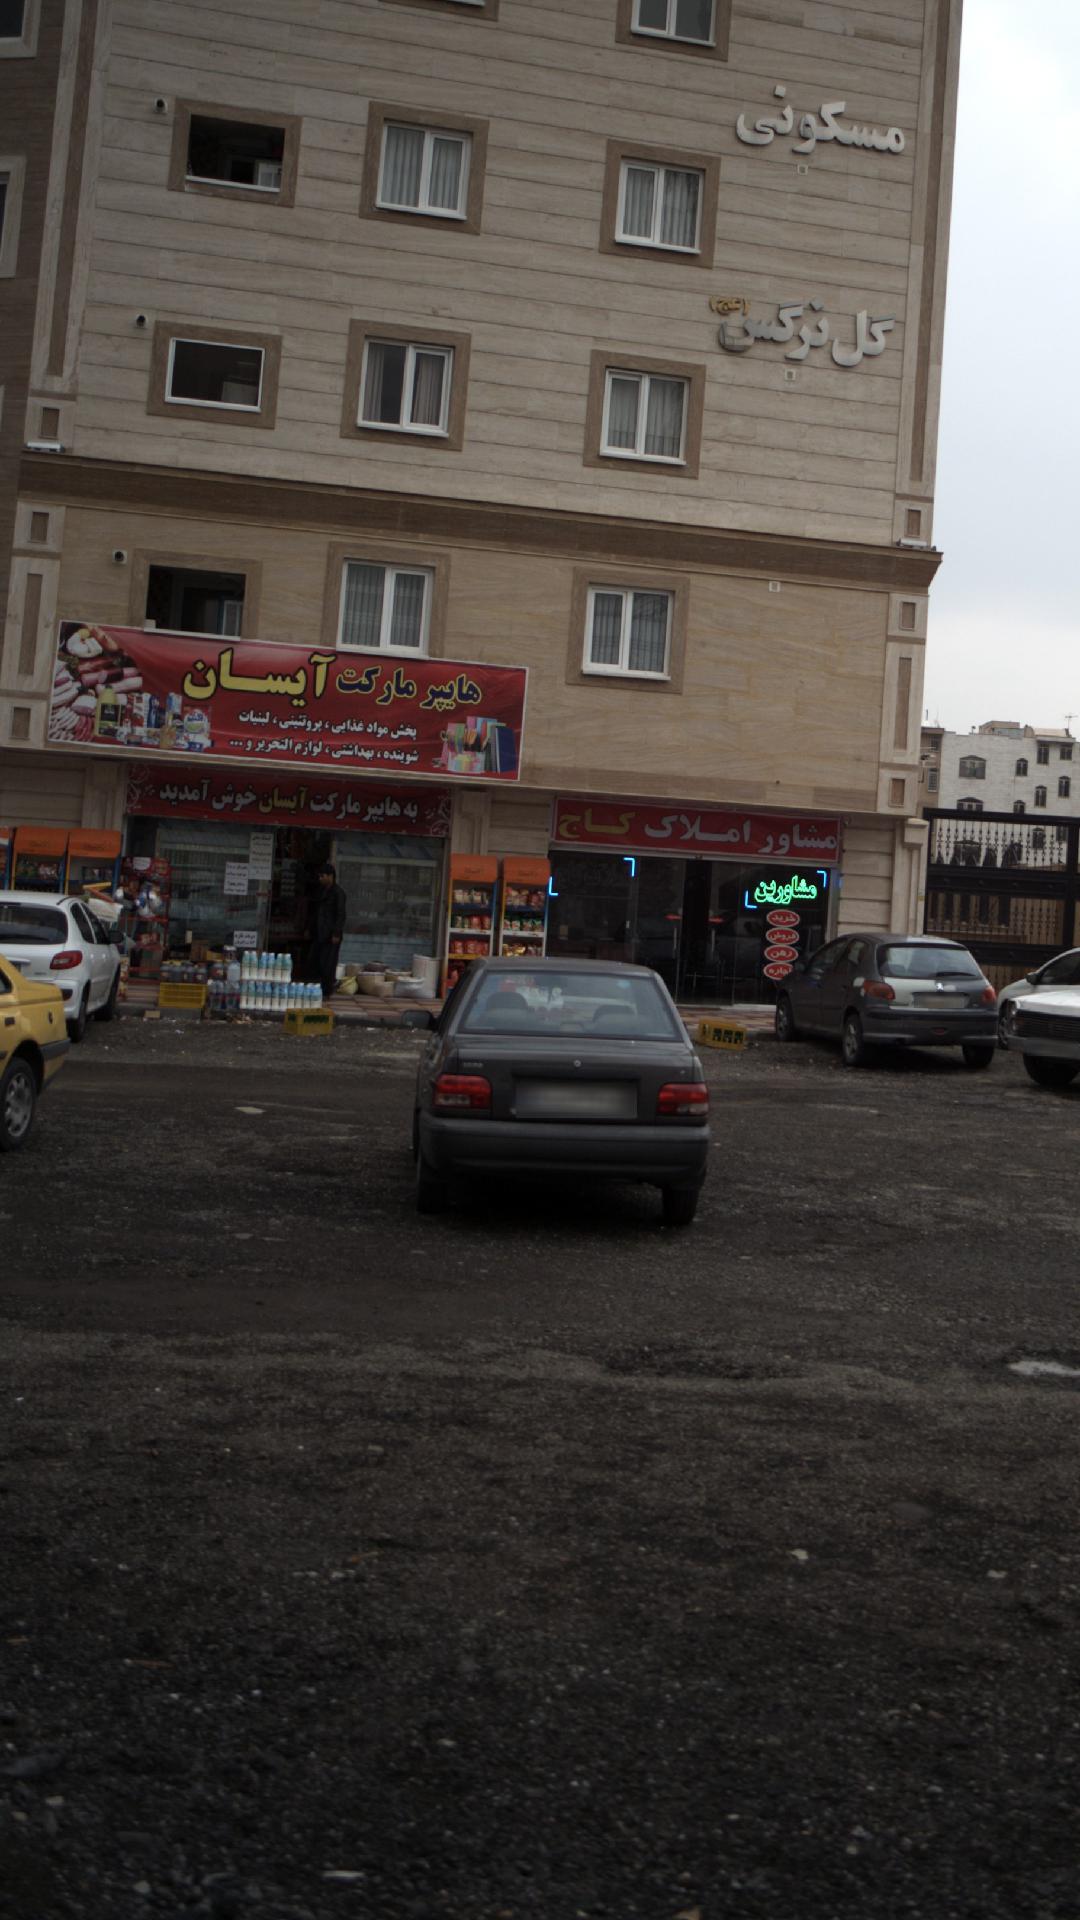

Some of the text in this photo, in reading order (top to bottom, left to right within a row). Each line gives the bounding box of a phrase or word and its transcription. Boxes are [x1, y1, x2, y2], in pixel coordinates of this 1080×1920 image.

[735, 84, 906, 154] مسکونی
[718, 297, 897, 367] گل نرگس
[181, 647, 482, 711] هایپر مارکت آیسان
[238, 709, 270, 724] لبنیات
[366, 720, 389, 738] مواد
[391, 723, 418, 741] بخش
[245, 739, 253, 751] و
[255, 737, 293, 753] التحریر
[295, 741, 323, 757] لوازم
[159, 779, 419, 824] به هایپر مارکت آیسان خوش آمدید
[558, 808, 838, 855] مشاور املاک کاج
[753, 874, 818, 905] مشاورین
[771, 914, 797, 922] خرید
[769, 931, 797, 941] فروش
[770, 949, 794, 958] رهن
